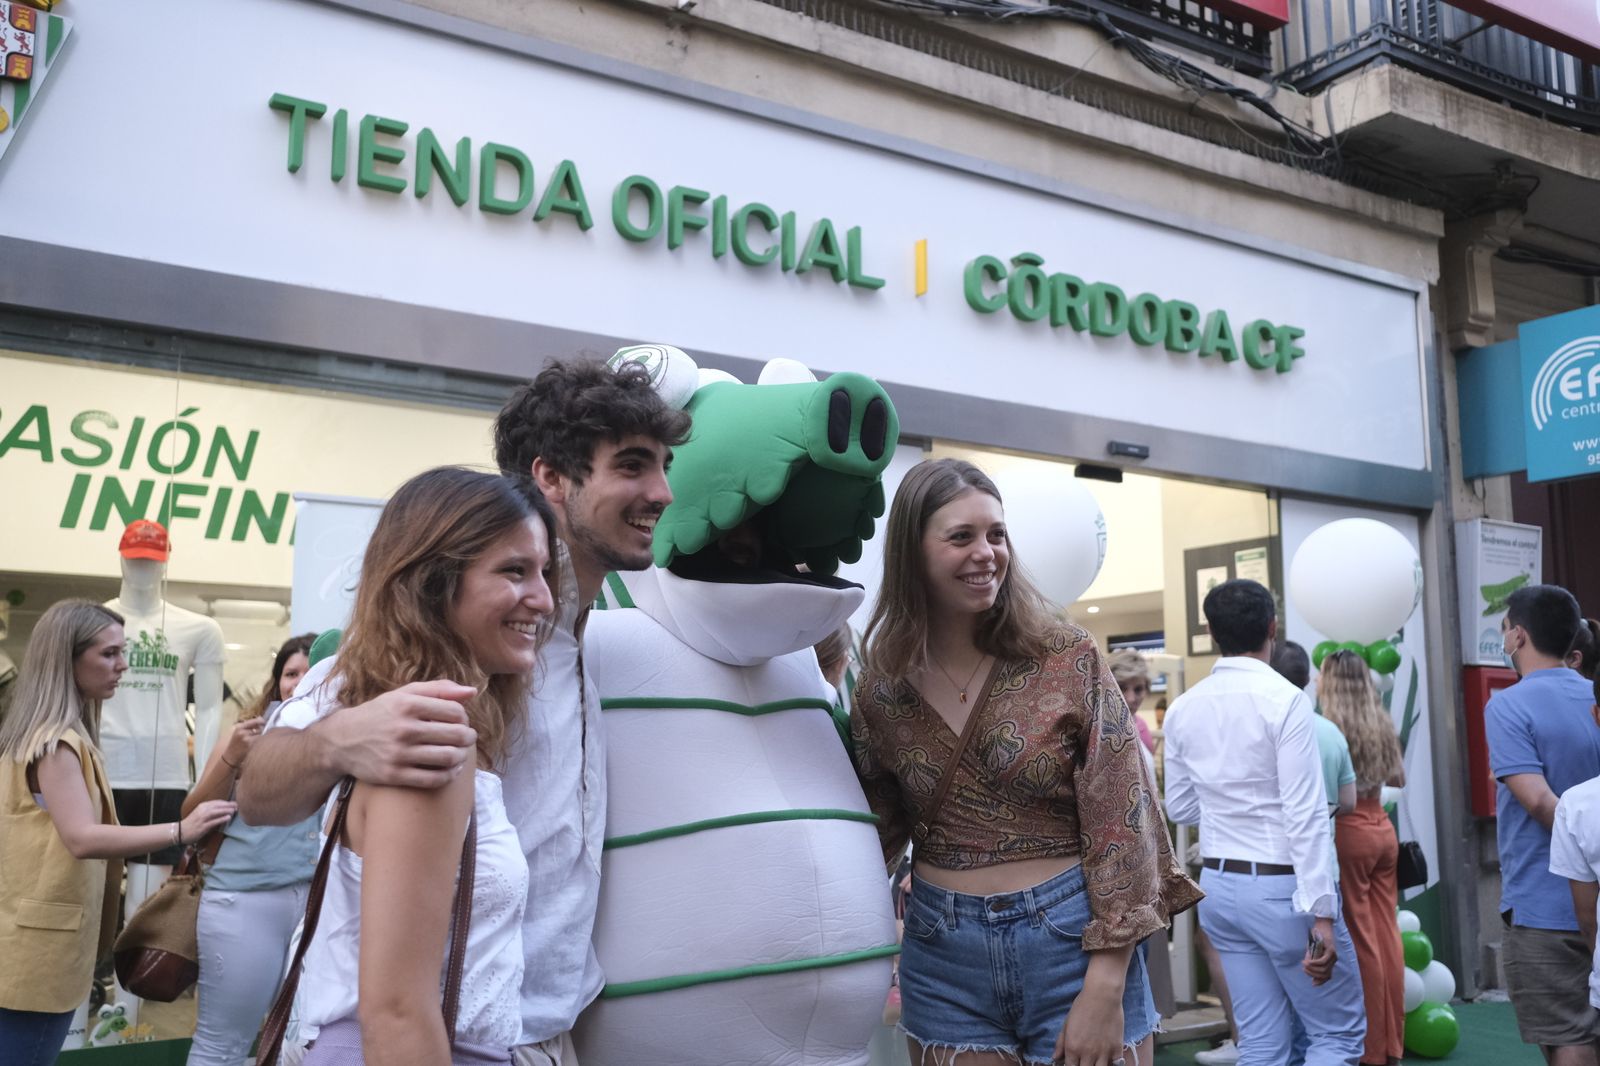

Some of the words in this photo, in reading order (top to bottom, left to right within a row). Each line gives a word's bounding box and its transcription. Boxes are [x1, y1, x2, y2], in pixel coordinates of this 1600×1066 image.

[268, 92, 594, 232] TIENDA
[612, 174, 886, 291] OFICIAL
[1242, 319, 1305, 374] CF
[0, 404, 259, 482] ASIÓN
[1573, 436, 1600, 452] ww
[60, 473, 297, 547] INFIN
